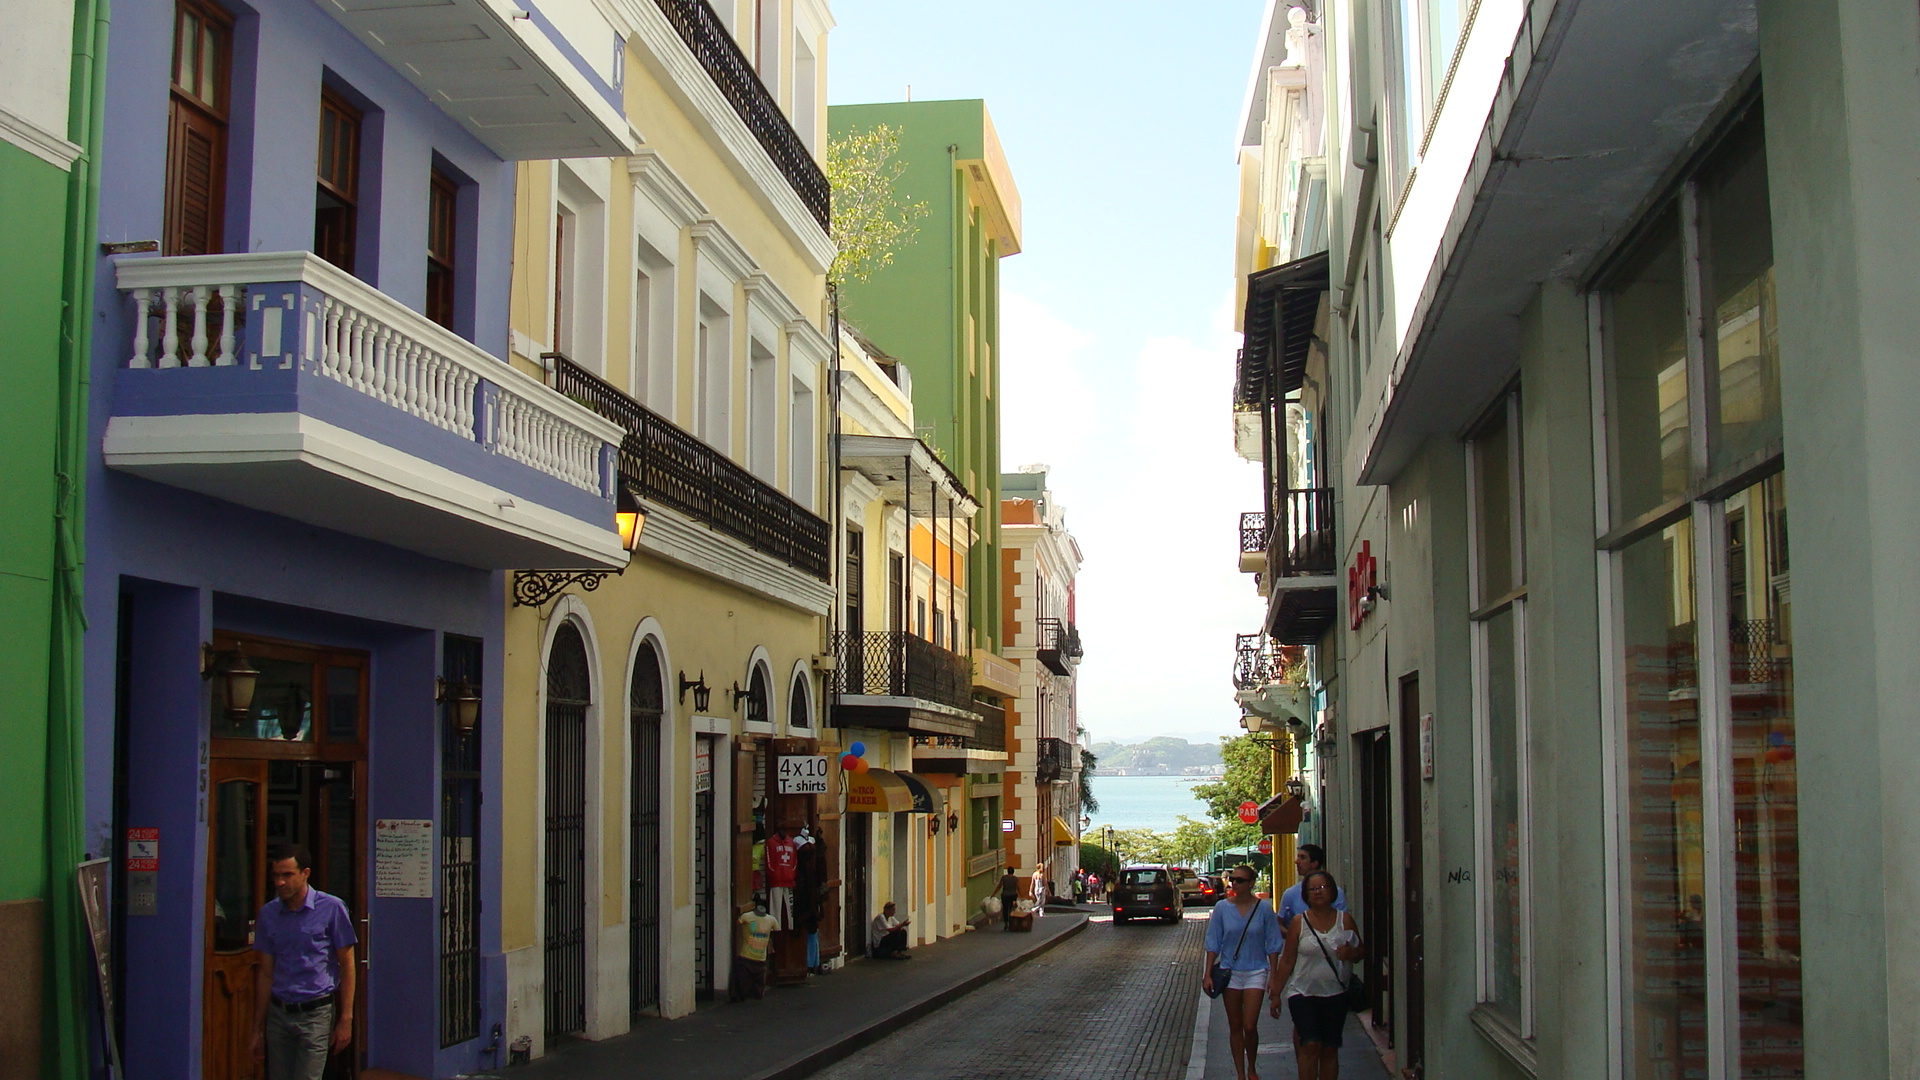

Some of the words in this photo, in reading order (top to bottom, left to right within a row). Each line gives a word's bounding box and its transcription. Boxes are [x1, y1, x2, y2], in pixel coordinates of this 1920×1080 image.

[199, 741, 207, 822] 251
[796, 780, 826, 791] shirts
[858, 786, 875, 794] TACO
[849, 796, 877, 805] MAKER
[128, 829, 141, 839] 24
[128, 859, 141, 869] 24
